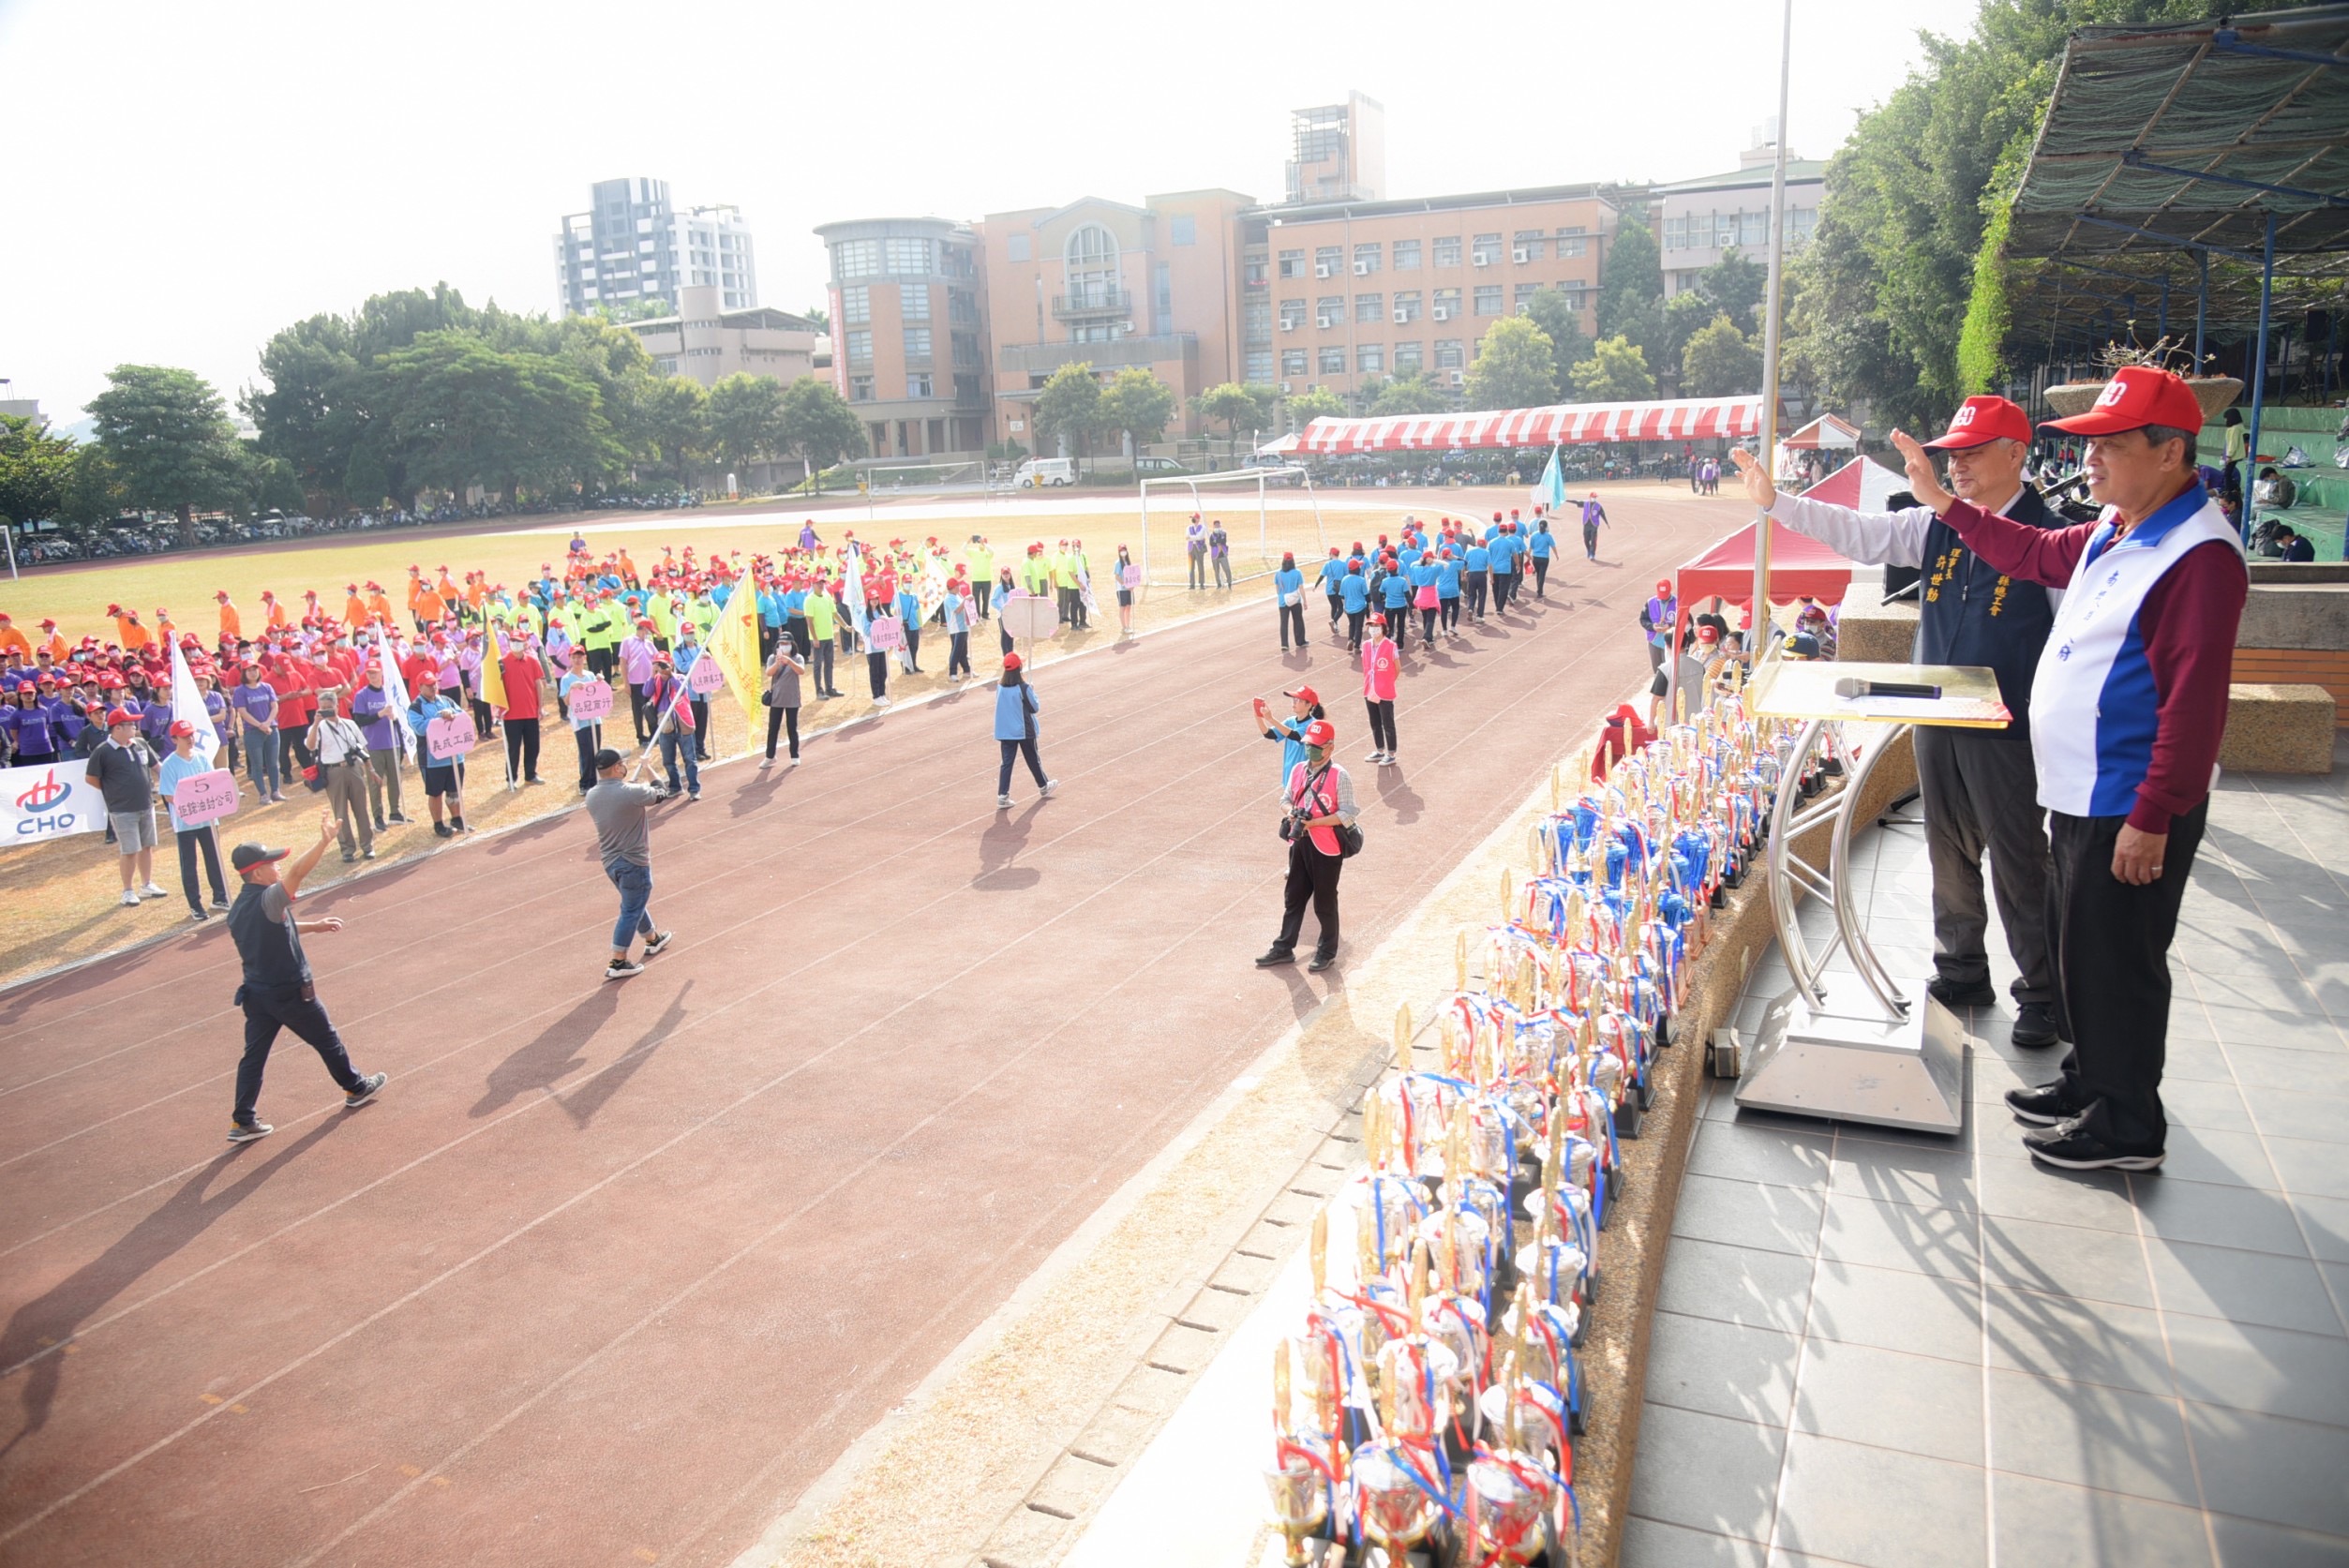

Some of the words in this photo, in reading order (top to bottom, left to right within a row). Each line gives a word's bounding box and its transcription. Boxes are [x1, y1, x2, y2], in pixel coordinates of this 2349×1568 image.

[1945, 548, 1962, 579] 理事長
[703, 661, 711, 672] 11
[585, 684, 596, 696] 9
[194, 777, 210, 793] 5
[16, 813, 76, 835] CHO
